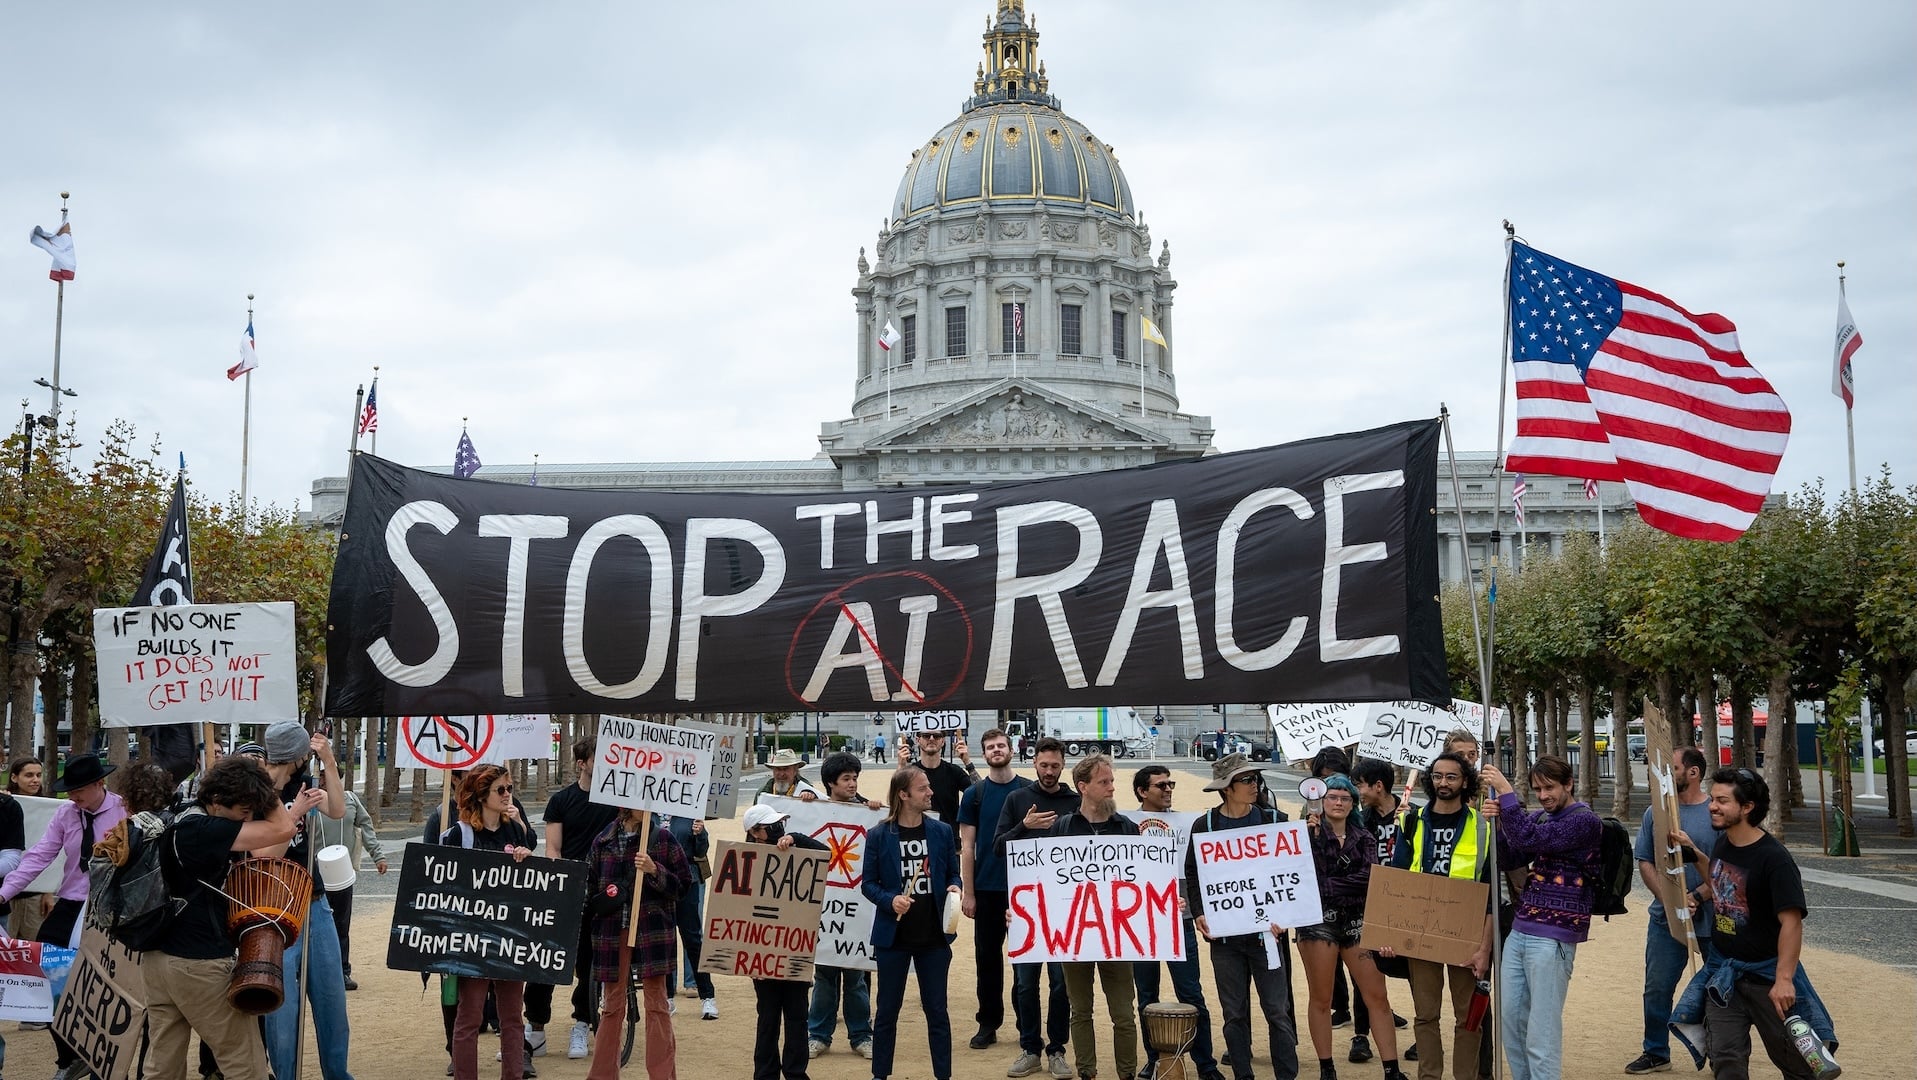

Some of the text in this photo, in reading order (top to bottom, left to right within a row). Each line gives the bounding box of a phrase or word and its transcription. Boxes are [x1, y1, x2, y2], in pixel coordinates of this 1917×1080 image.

[796, 493, 980, 569] THE
[984, 469, 1405, 691] RACE
[365, 500, 787, 702] STOP
[113, 611, 242, 637] IF NO ONE
[137, 639, 234, 657] BUILDS IT
[801, 595, 938, 703] AI
[126, 653, 271, 683] IT DOES NOT
[149, 675, 265, 710] GET BUILT
[414, 716, 479, 752] ASI
[602, 719, 715, 752] AND HONESTLY?
[897, 714, 961, 731] WE DID
[1289, 717, 1344, 739] RUNS
[1302, 727, 1362, 751] FAIL
[1372, 713, 1448, 750] SATISF
[719, 735, 736, 749] AI
[719, 750, 737, 763] YOU
[1400, 747, 1429, 766] PAUSE
[605, 743, 662, 771] STOP
[673, 759, 697, 775] the
[720, 766, 733, 779] IS
[600, 769, 635, 797] AI
[642, 775, 705, 808] RACE!
[709, 783, 731, 796] EVE
[1008, 839, 1178, 868] task environment
[1200, 834, 1270, 864] PAUSE
[1275, 829, 1302, 857] AI
[424, 855, 568, 892] YOU WOULDN'T
[715, 849, 830, 904] AI RACE
[1056, 863, 1137, 884] seems
[1206, 872, 1300, 896] BEFORE IT'S
[415, 892, 556, 926] DOWNLOAD THE
[1209, 888, 1296, 912] TOO LATE
[1008, 876, 1180, 960] SWARM
[397, 924, 566, 971] TORMENT NEXUS
[709, 918, 816, 953] EXTINCTION
[101, 944, 116, 979] the
[734, 951, 788, 978] RACE
[21, 979, 44, 988] Signal
[73, 957, 131, 1035] NERD
[56, 992, 119, 1079] REICH
